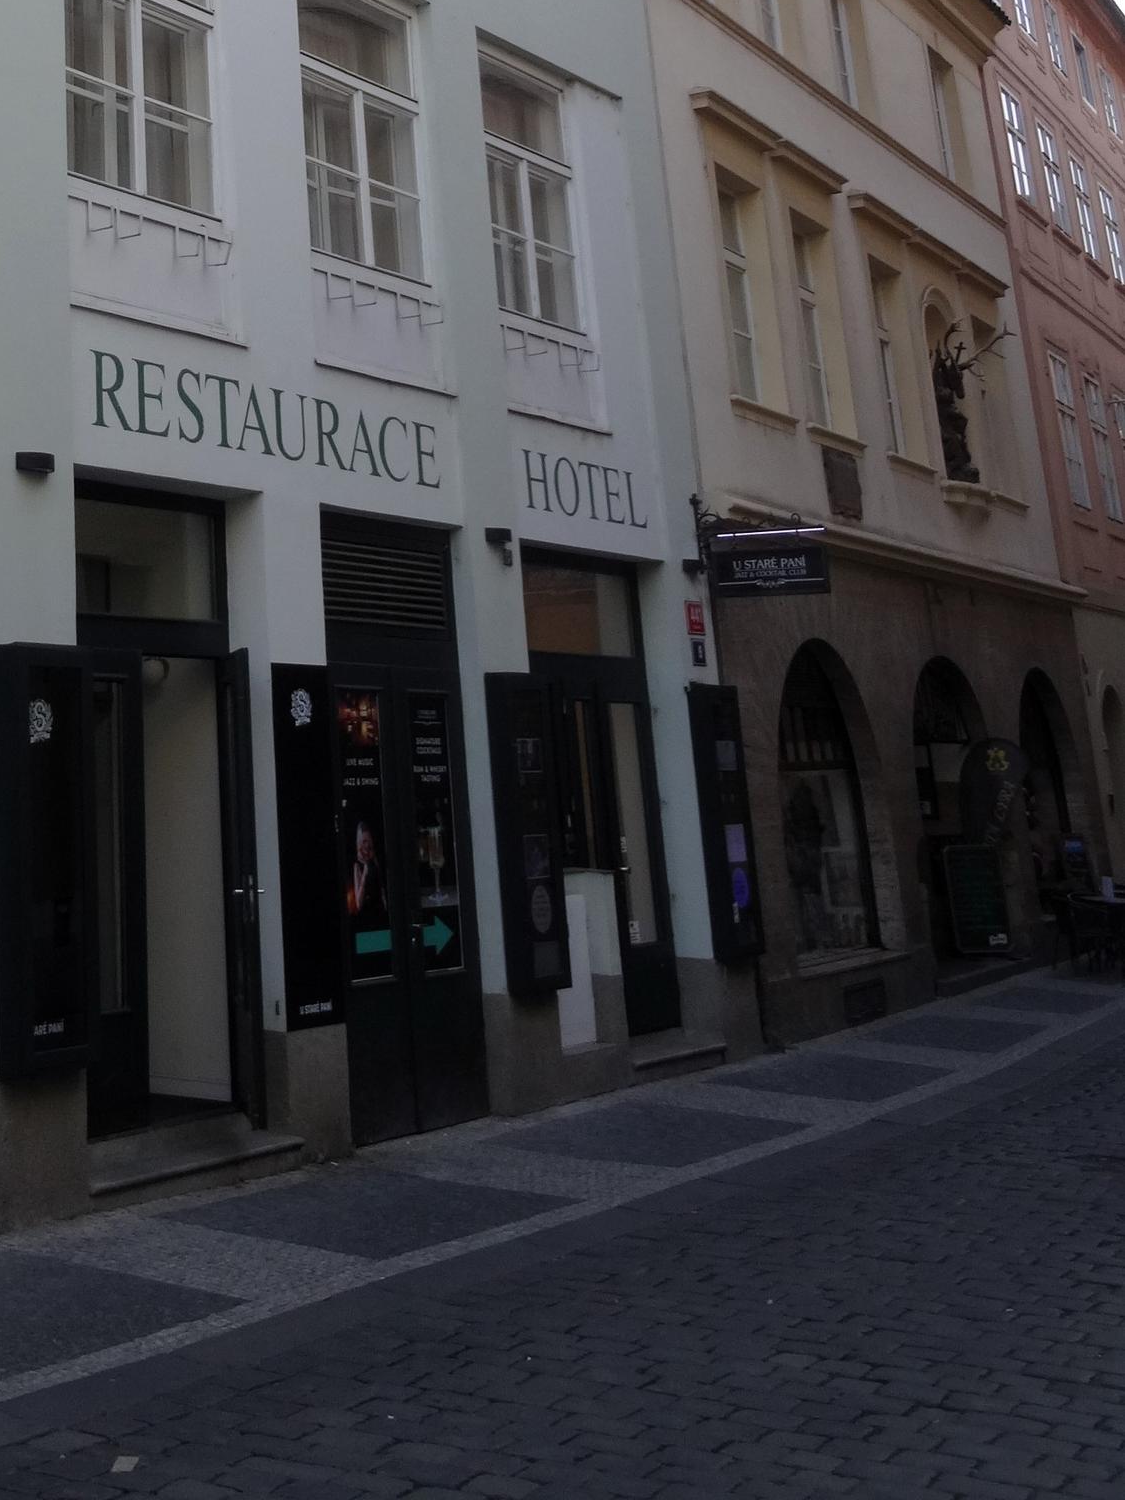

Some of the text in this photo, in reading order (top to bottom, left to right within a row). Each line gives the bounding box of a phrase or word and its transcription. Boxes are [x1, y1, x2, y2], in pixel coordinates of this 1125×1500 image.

[89, 348, 442, 490] RESTAURACE
[521, 448, 649, 529] HOTEL
[732, 554, 807, 571] U STARÉ PANÍ
[788, 568, 807, 576] CLUB
[346, 757, 374, 766] LIVE MUSIC
[343, 777, 355, 786] JAZZ
[361, 777, 380, 786] SWING
[34, 1016, 65, 1037] ARÉ PANÍ
